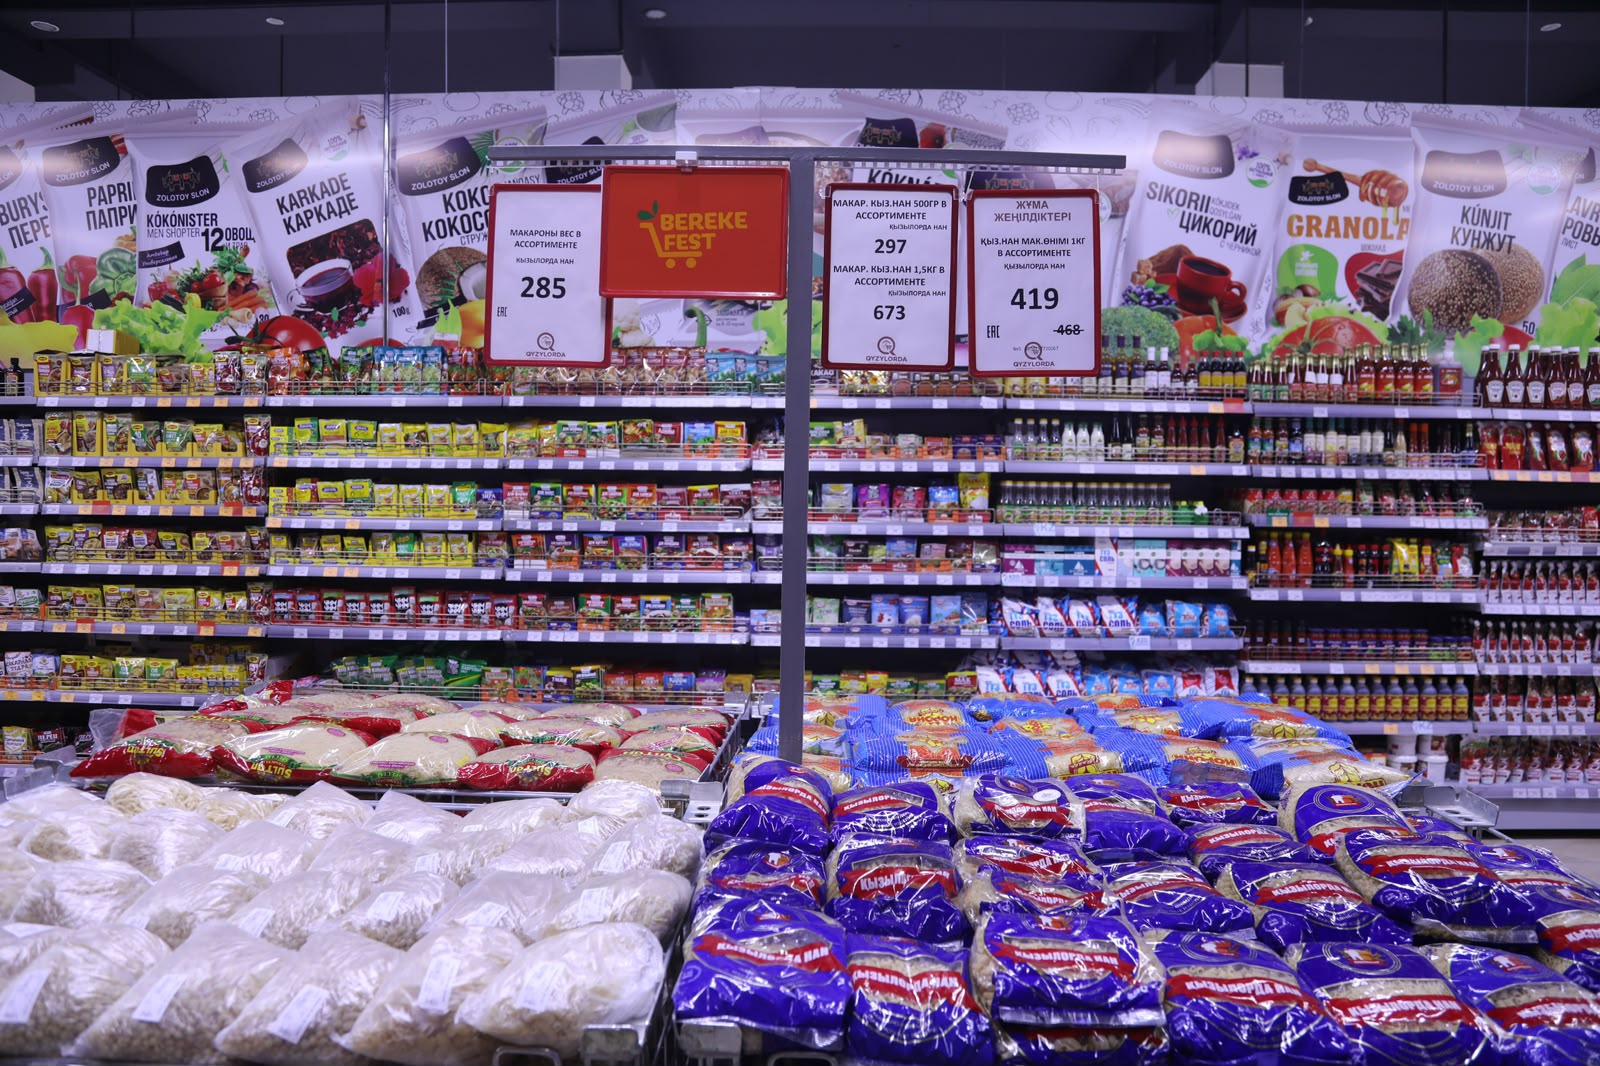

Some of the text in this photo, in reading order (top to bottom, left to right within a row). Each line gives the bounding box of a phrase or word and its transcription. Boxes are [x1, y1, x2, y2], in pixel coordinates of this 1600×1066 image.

[55, 161, 111, 181] ZOLOTOY SLON
[411, 166, 471, 191] ZOLOTOY SLON
[256, 173, 284, 188] ZOLOTOY
[1432, 180, 1495, 194] ZOLOTOY SLON
[156, 187, 210, 202] ZOLOTOY SLON
[276, 172, 351, 215] KARKADE
[1146, 181, 1212, 214] SIKORII
[833, 199, 948, 208] МАКАР. КЫЗ.НАН 500ГР В
[1016, 200, 1049, 210] ЖҰМА
[283, 192, 359, 235] КАРКАДЕ
[855, 211, 927, 220] АССОРТИМЕНТЕ
[993, 212, 1072, 223] ЖЕҢІЛДІКТЕРІ
[1460, 203, 1512, 231] KÚNJIT
[660, 211, 749, 232] BEREKE
[1179, 210, 1258, 247] ЦИКОРИЙ
[1286, 213, 1410, 241] GRANOLA
[201, 227, 225, 252] 12
[510, 229, 582, 238] МАКАРОНЫ ВЕС В
[1021, 237, 1069, 245] МАК.ӨНІМІ
[1071, 237, 1086, 245] 1КГ
[1450, 225, 1516, 255] КУНЖУТ
[514, 240, 578, 249] АССОРТИМЕНТЕ
[664, 232, 718, 251] FEST
[874, 238, 907, 254] 297
[997, 249, 1072, 257] В АССОРТИМЕНТЕ
[833, 265, 869, 273] МАКАР.
[871, 265, 912, 273] КЫЗ.НАН
[914, 265, 938, 274] 1,5КГ
[520, 276, 567, 299] 285
[854, 277, 926, 286] АССОРТИМЕНТЕ
[1010, 287, 1060, 310] 419
[873, 304, 906, 321] 673
[1056, 324, 1082, 336] 468
[1108, 619, 1132, 628] СОЛЬ
[803, 948, 830, 963] НАН
[1094, 955, 1119, 966] НАН
[1274, 982, 1303, 997] НАН
